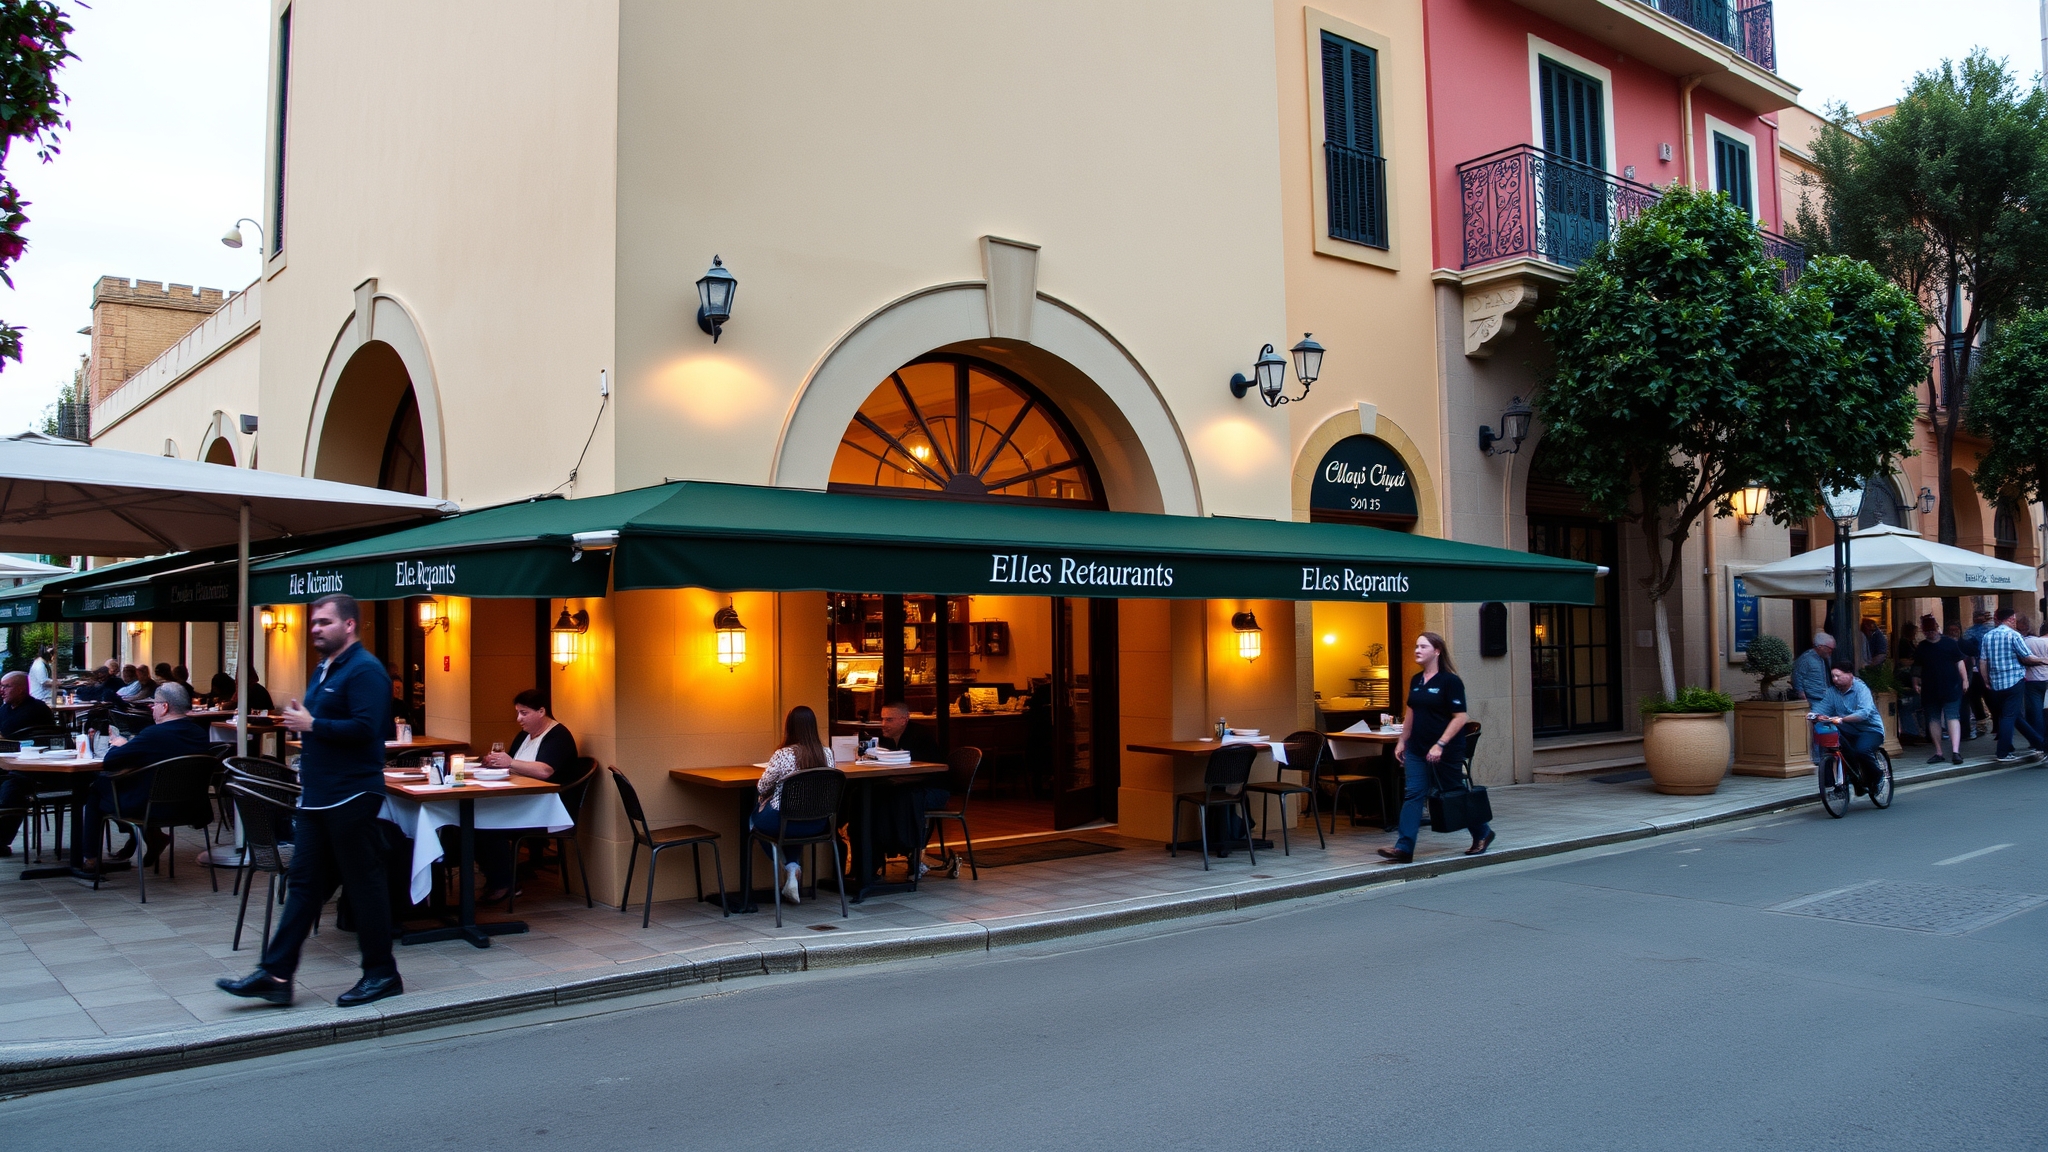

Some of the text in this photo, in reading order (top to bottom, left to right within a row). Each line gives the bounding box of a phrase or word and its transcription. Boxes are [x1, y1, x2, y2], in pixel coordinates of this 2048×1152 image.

[989, 554, 1174, 587] Elles Retaurants
[1301, 567, 1340, 591] Eles
